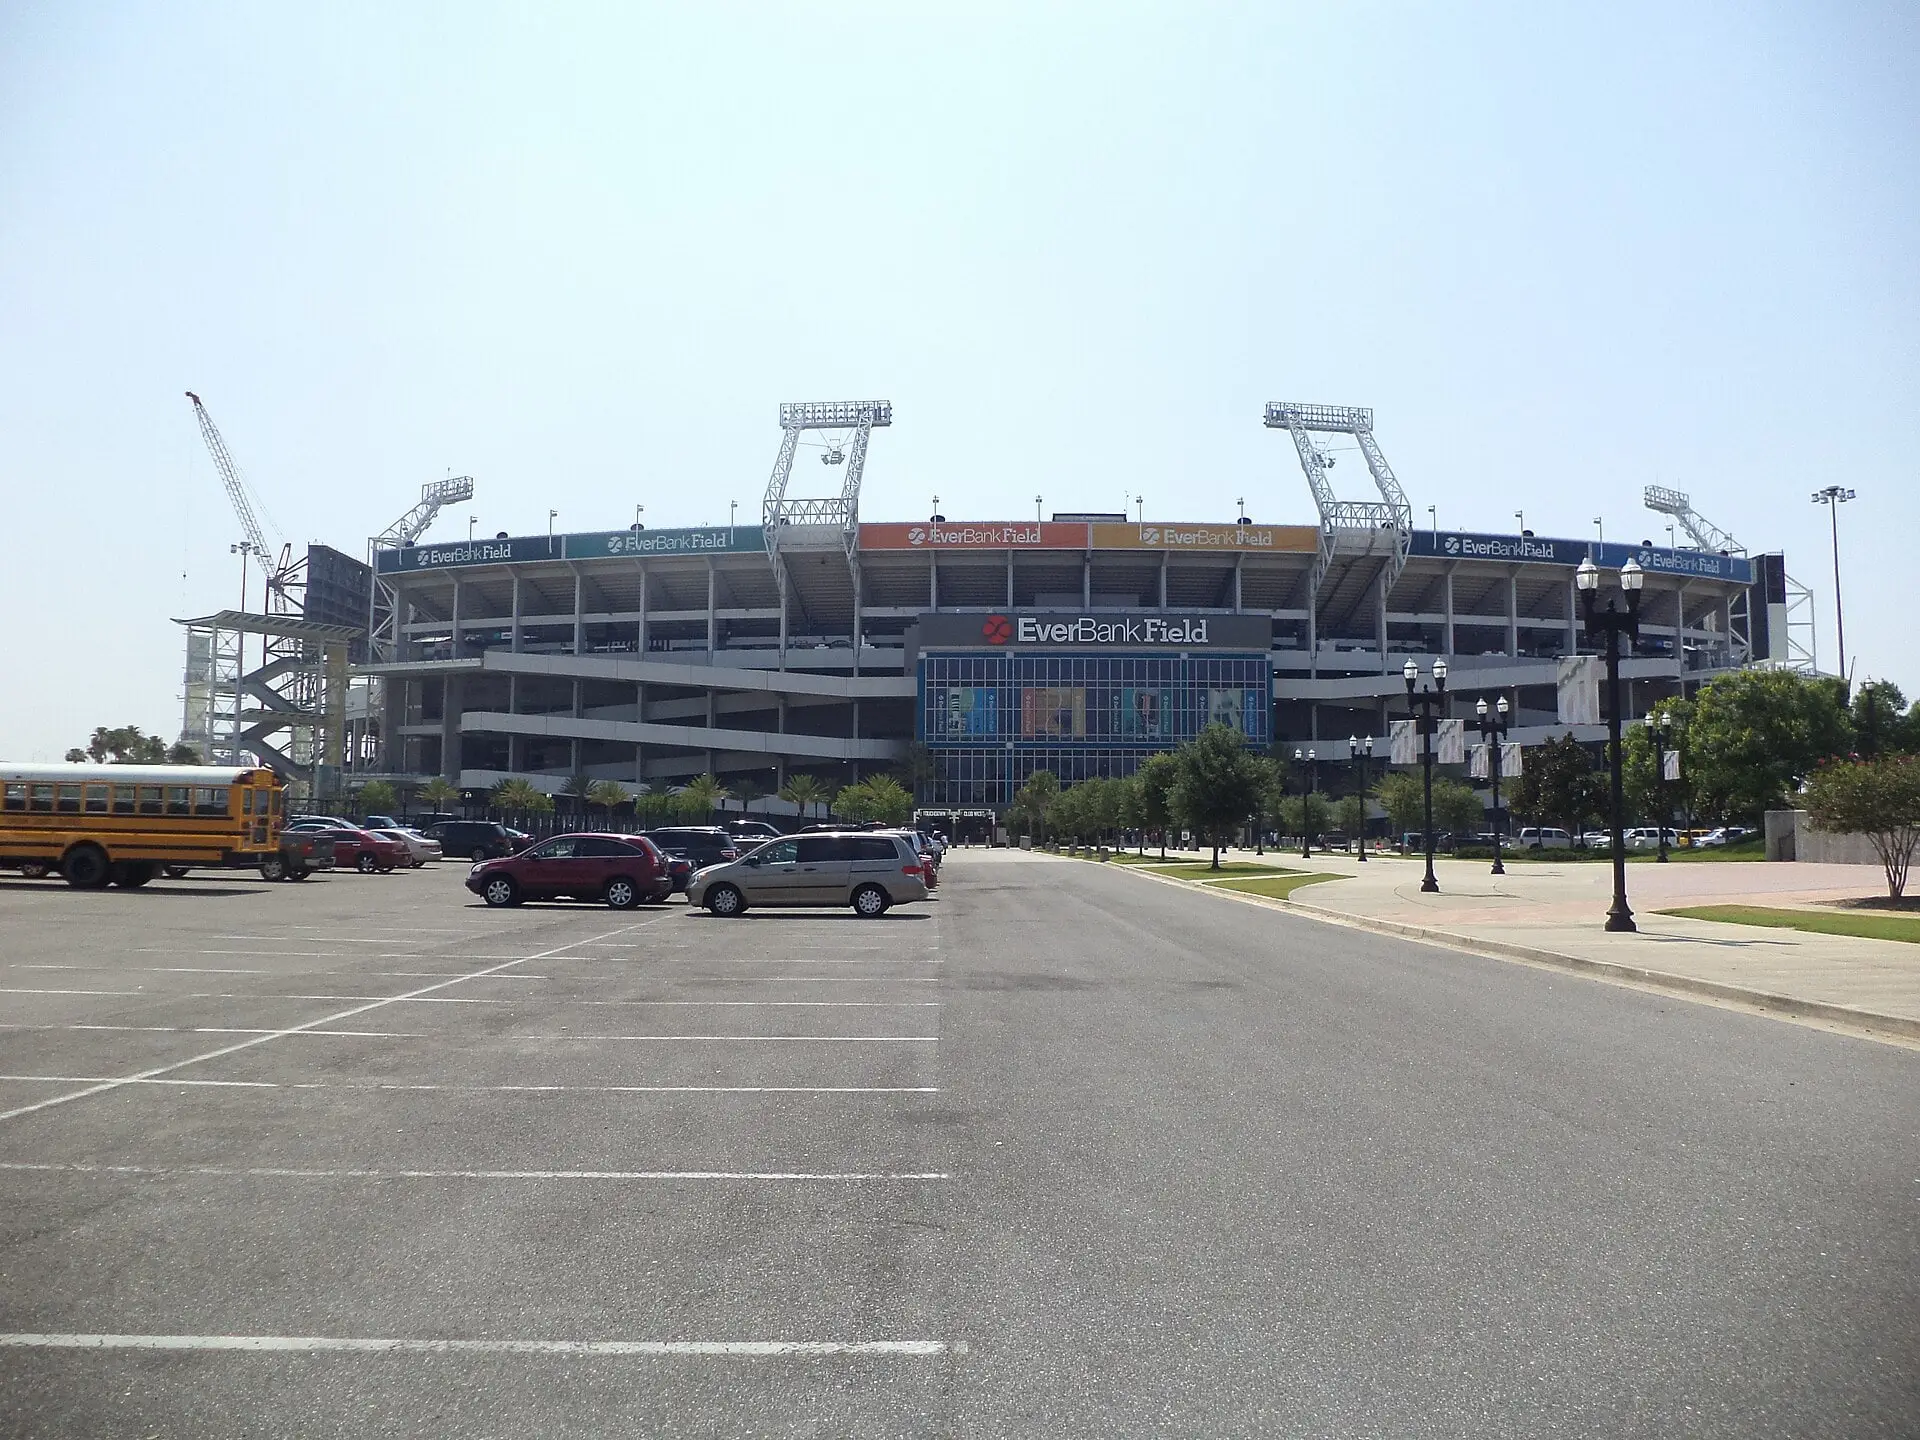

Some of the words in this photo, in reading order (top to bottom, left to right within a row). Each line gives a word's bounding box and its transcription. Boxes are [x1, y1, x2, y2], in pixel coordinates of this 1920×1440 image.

[691, 532, 726, 549] Field
[483, 544, 511, 559] Field
[1018, 617, 1142, 642] EverBank
[1143, 618, 1209, 643] Field
